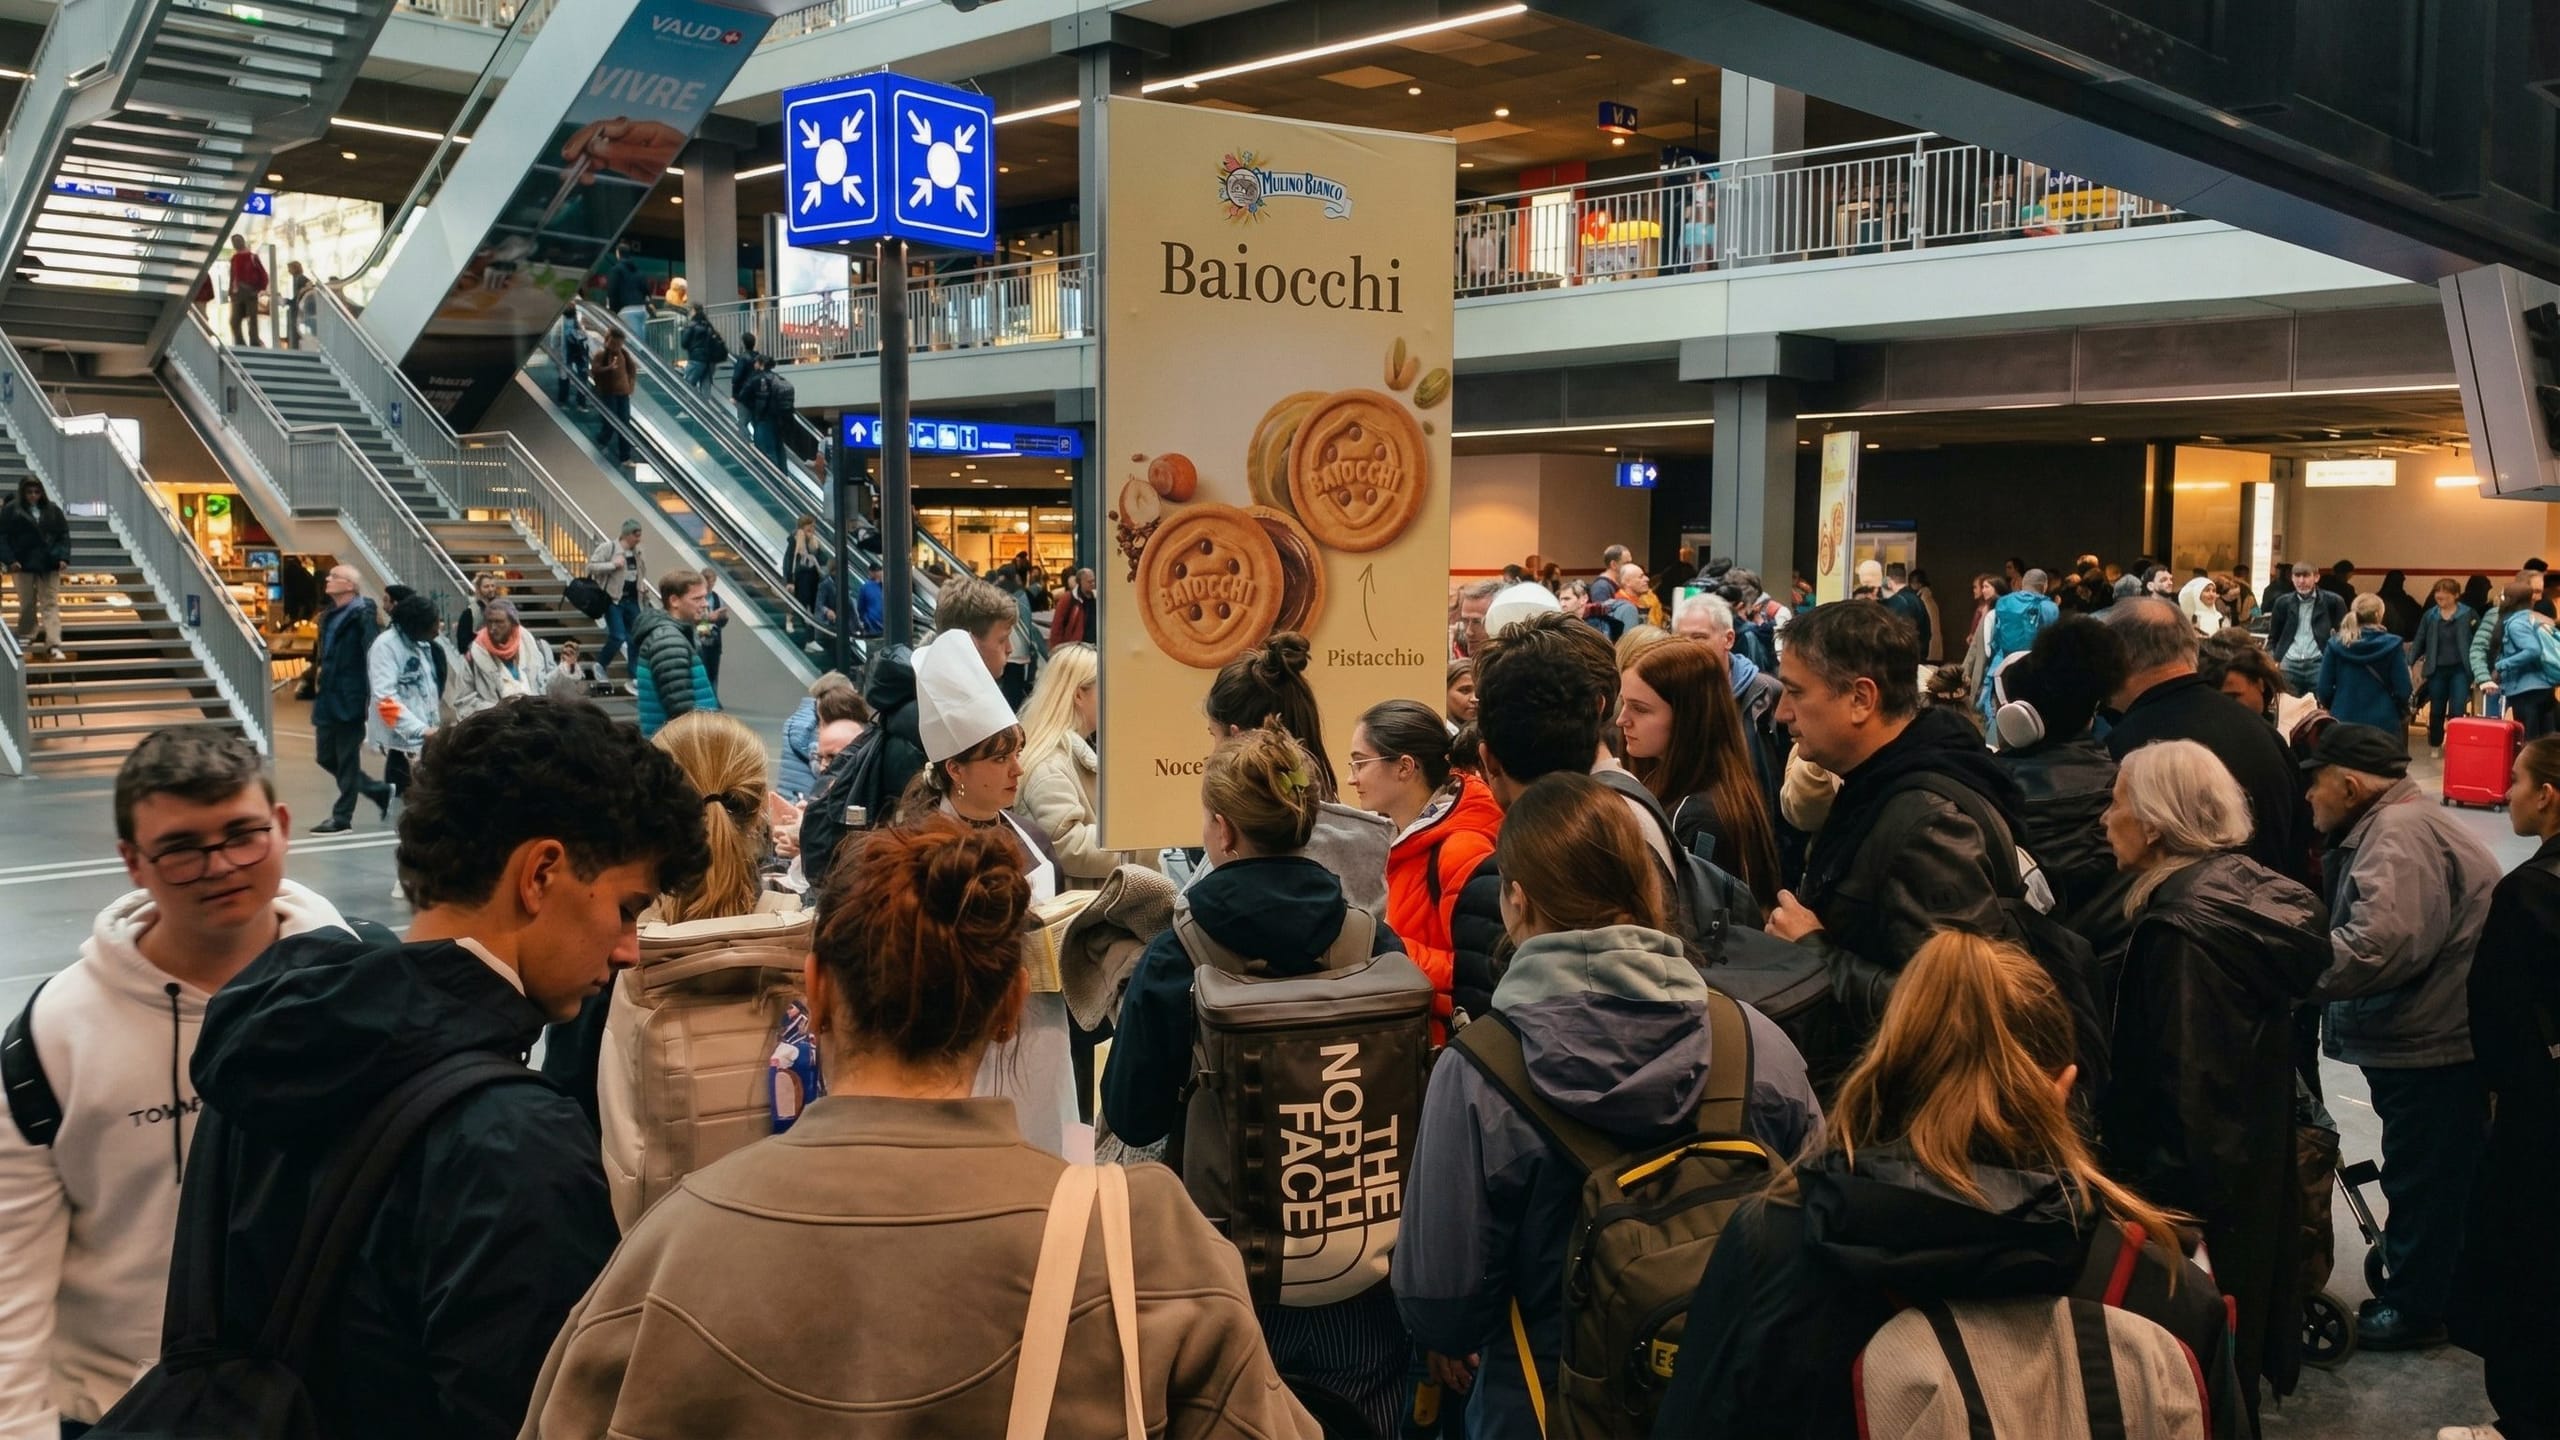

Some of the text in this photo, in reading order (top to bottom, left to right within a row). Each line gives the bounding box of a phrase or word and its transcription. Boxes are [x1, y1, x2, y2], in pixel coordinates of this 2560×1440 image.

[652, 15, 722, 41] VAUD
[588, 65, 706, 113] VIVRE
[1262, 171, 1343, 201] MULINO BIANCO
[1160, 241, 1404, 313] Baiocchi
[1310, 459, 1404, 496] BAIOCCHI
[1159, 575, 1256, 615] BAIOCCHI
[1327, 648, 1425, 667] Pistacchio
[1154, 757, 1209, 777] Noce
[1320, 1043, 1364, 1228] NORTH
[1279, 1103, 1324, 1231] FACE
[1363, 1114, 1400, 1221] THE
